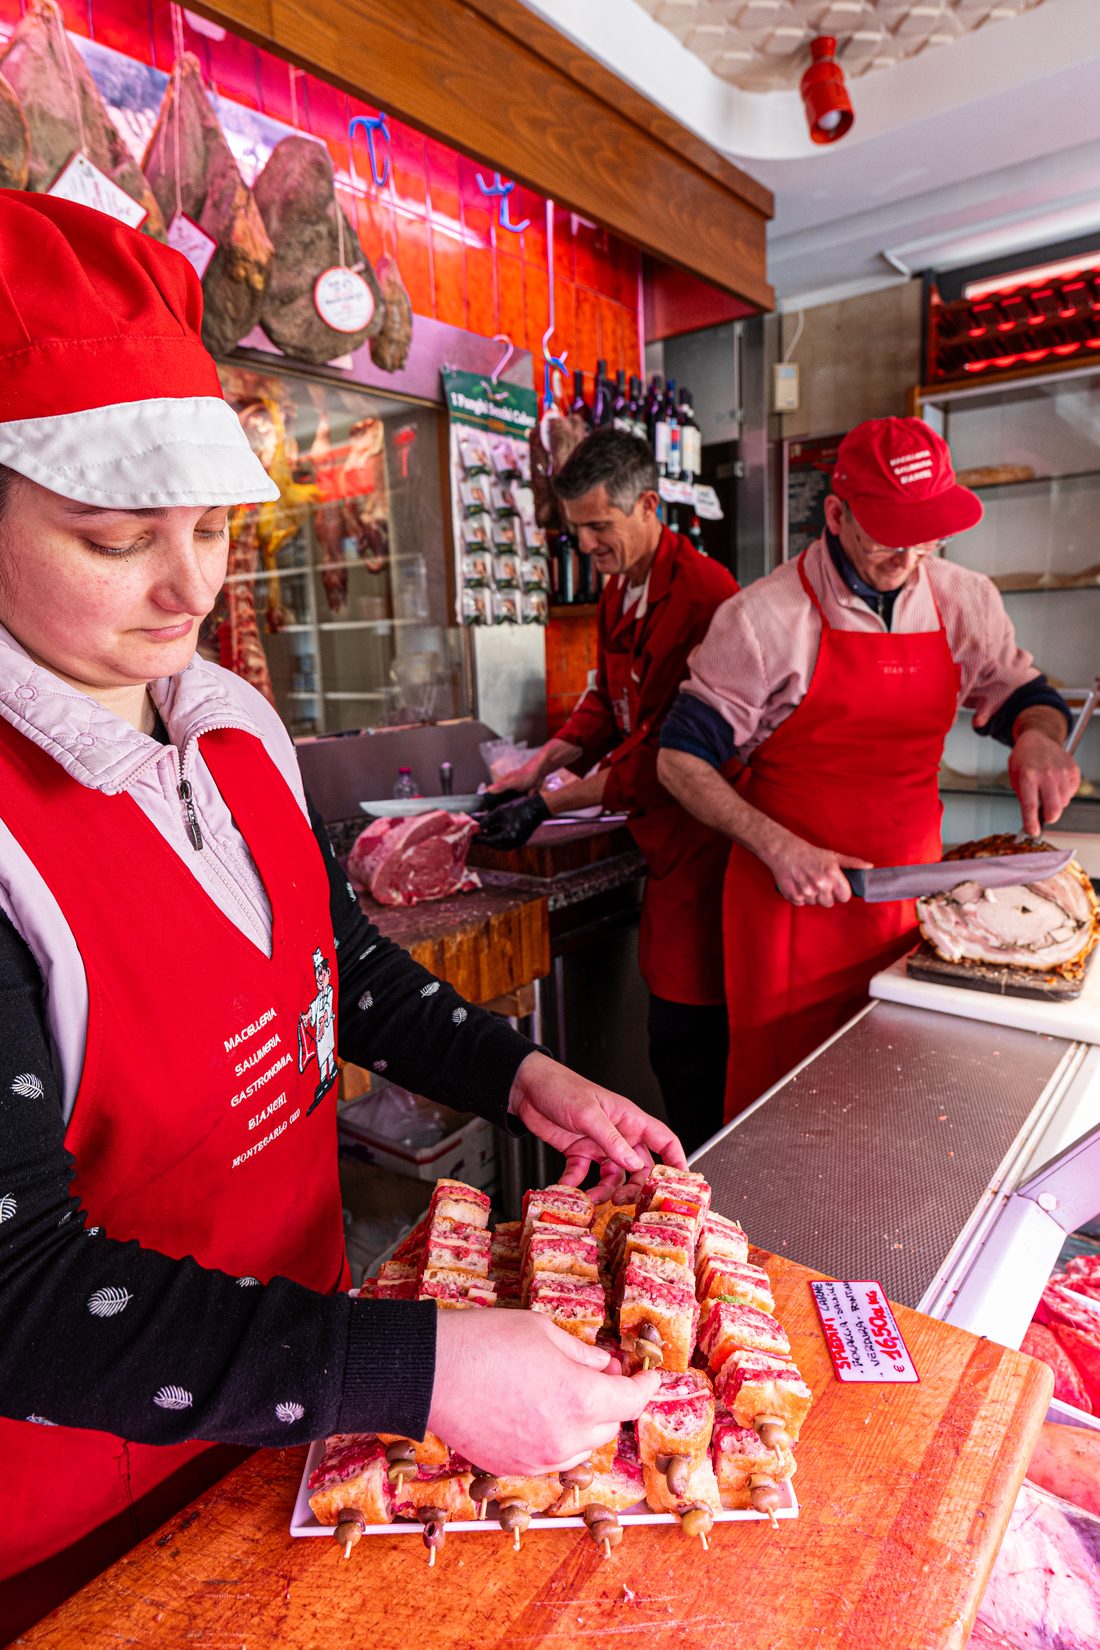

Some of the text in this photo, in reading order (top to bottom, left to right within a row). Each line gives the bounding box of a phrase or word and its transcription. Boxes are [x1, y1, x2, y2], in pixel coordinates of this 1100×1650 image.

[223, 1007, 278, 1053] MACELLERIA
[234, 1033, 282, 1077] SALUMERIA
[230, 1053, 294, 1108] GASTRONOMIA
[248, 1091, 288, 1131] BIANCHI
[231, 1120, 288, 1169] MONTECARLO
[813, 1283, 830, 1311] CARNE
[855, 1320, 880, 1367] VERDURA
